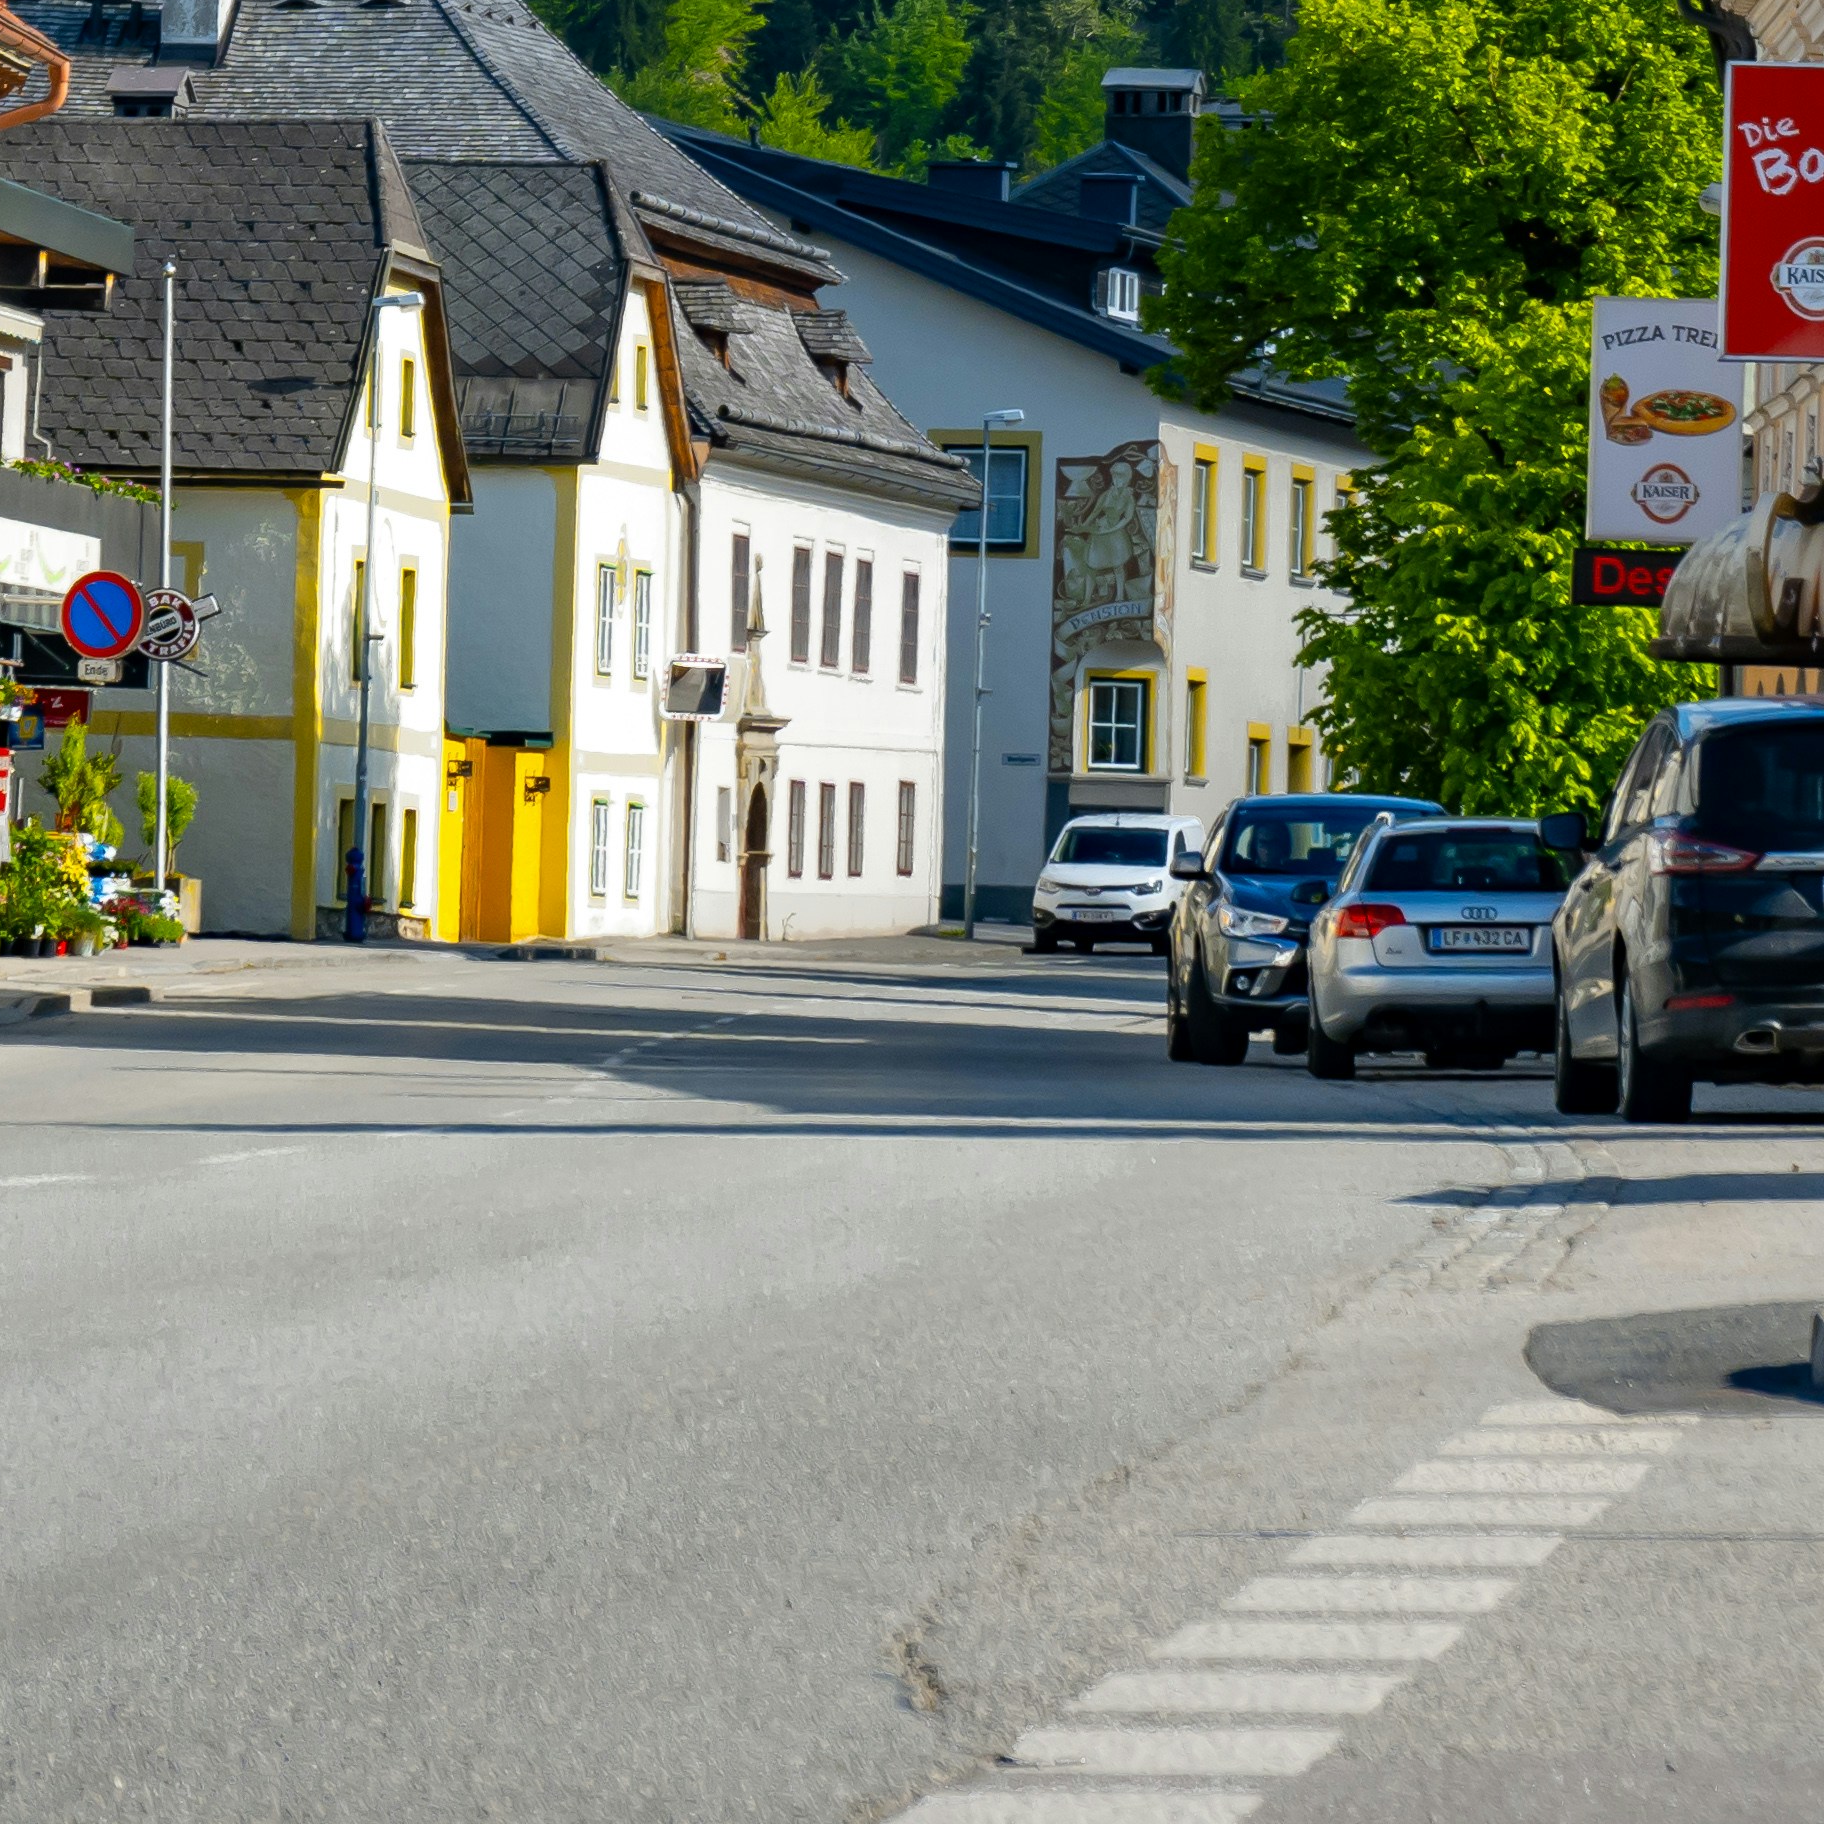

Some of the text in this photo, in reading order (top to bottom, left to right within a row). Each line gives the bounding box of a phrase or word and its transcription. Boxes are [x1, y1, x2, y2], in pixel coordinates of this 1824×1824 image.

[1737, 117, 1800, 148] Die
[1602, 325, 1666, 351] PIZZA
[1642, 484, 1690, 500] KAISER
[148, 594, 183, 610] BAK
[149, 621, 194, 656] TRAFIK
[84, 663, 108, 676] Ende
[1443, 930, 1462, 946] LF
[1474, 930, 1501, 946] 432
